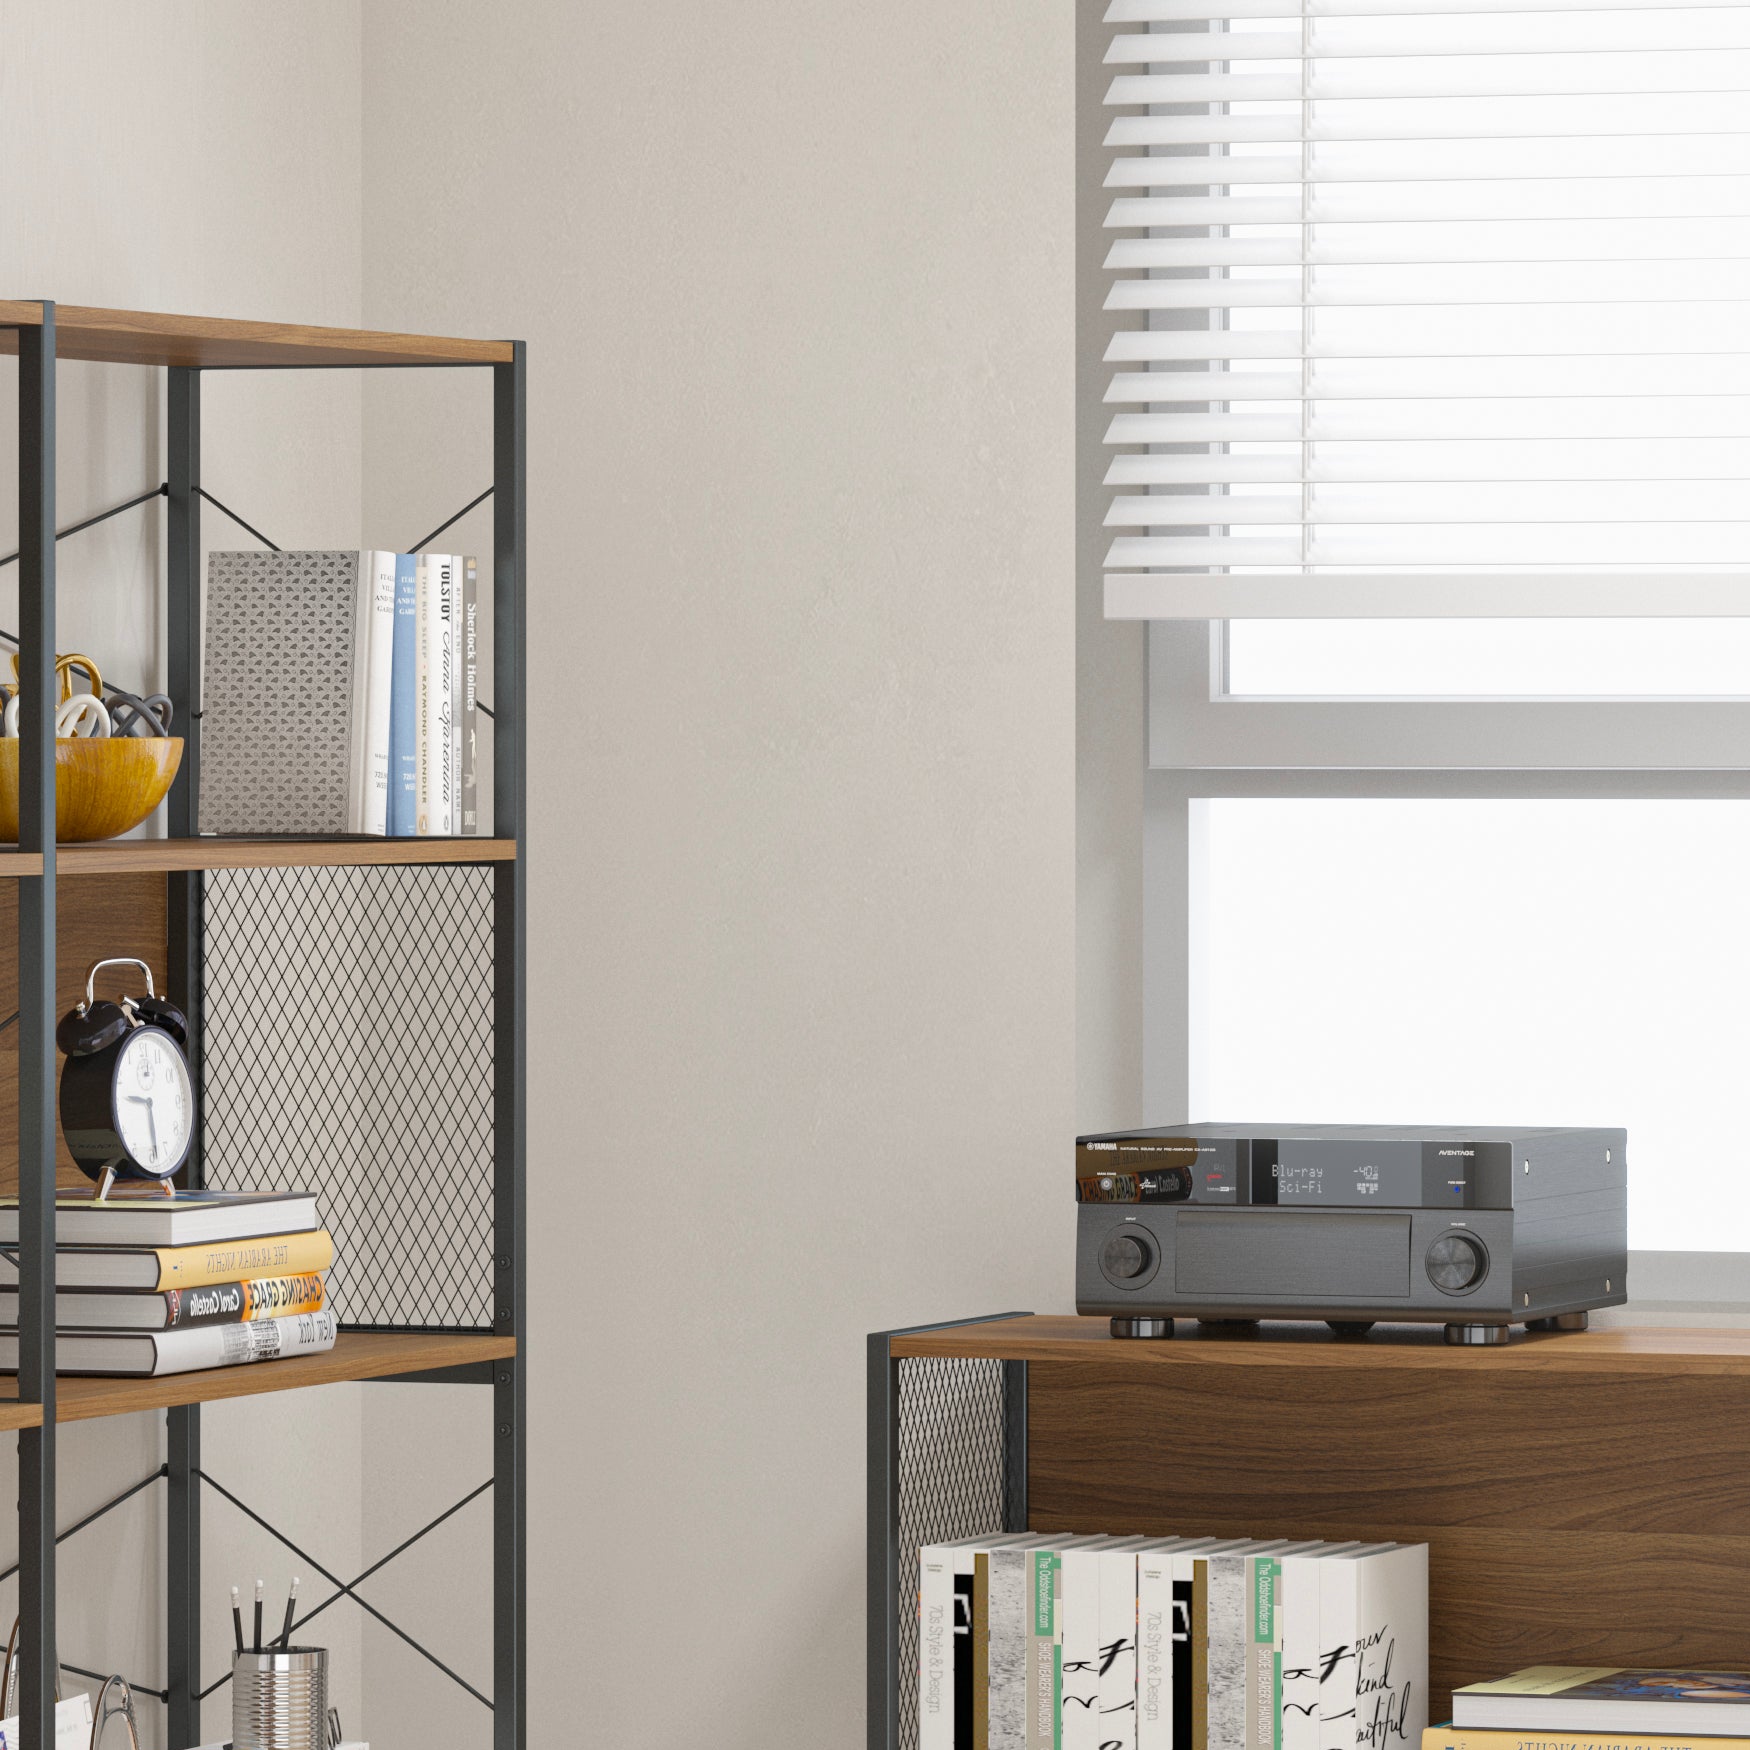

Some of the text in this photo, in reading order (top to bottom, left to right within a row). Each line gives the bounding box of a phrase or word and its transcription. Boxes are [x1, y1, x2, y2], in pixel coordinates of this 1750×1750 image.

[441, 564, 450, 622] TOLSTOY
[467, 603, 476, 711] Sherlock Holmes
[1094, 1142, 1118, 1150] YAMAHA
[1272, 1164, 1323, 1178] Blu-ray
[1280, 1180, 1322, 1194] Sci-Fi
[1040, 1557, 1051, 1628] The Oddshoefinder.com
[1260, 1564, 1272, 1636] The Oddshoefinder.com
[926, 1605, 943, 1713] 70s Style & Design
[1038, 1642, 1051, 1660] SHOE
[1144, 1612, 1162, 1721] 70s Style & Design
[1258, 1649, 1271, 1669] SHOE
[1038, 1662, 1051, 1696] WEARER'S
[1258, 1670, 1271, 1706] WEARER'S
[1038, 1698, 1051, 1737] HANDBOOK
[1258, 1708, 1271, 1745] HANDBOOK
